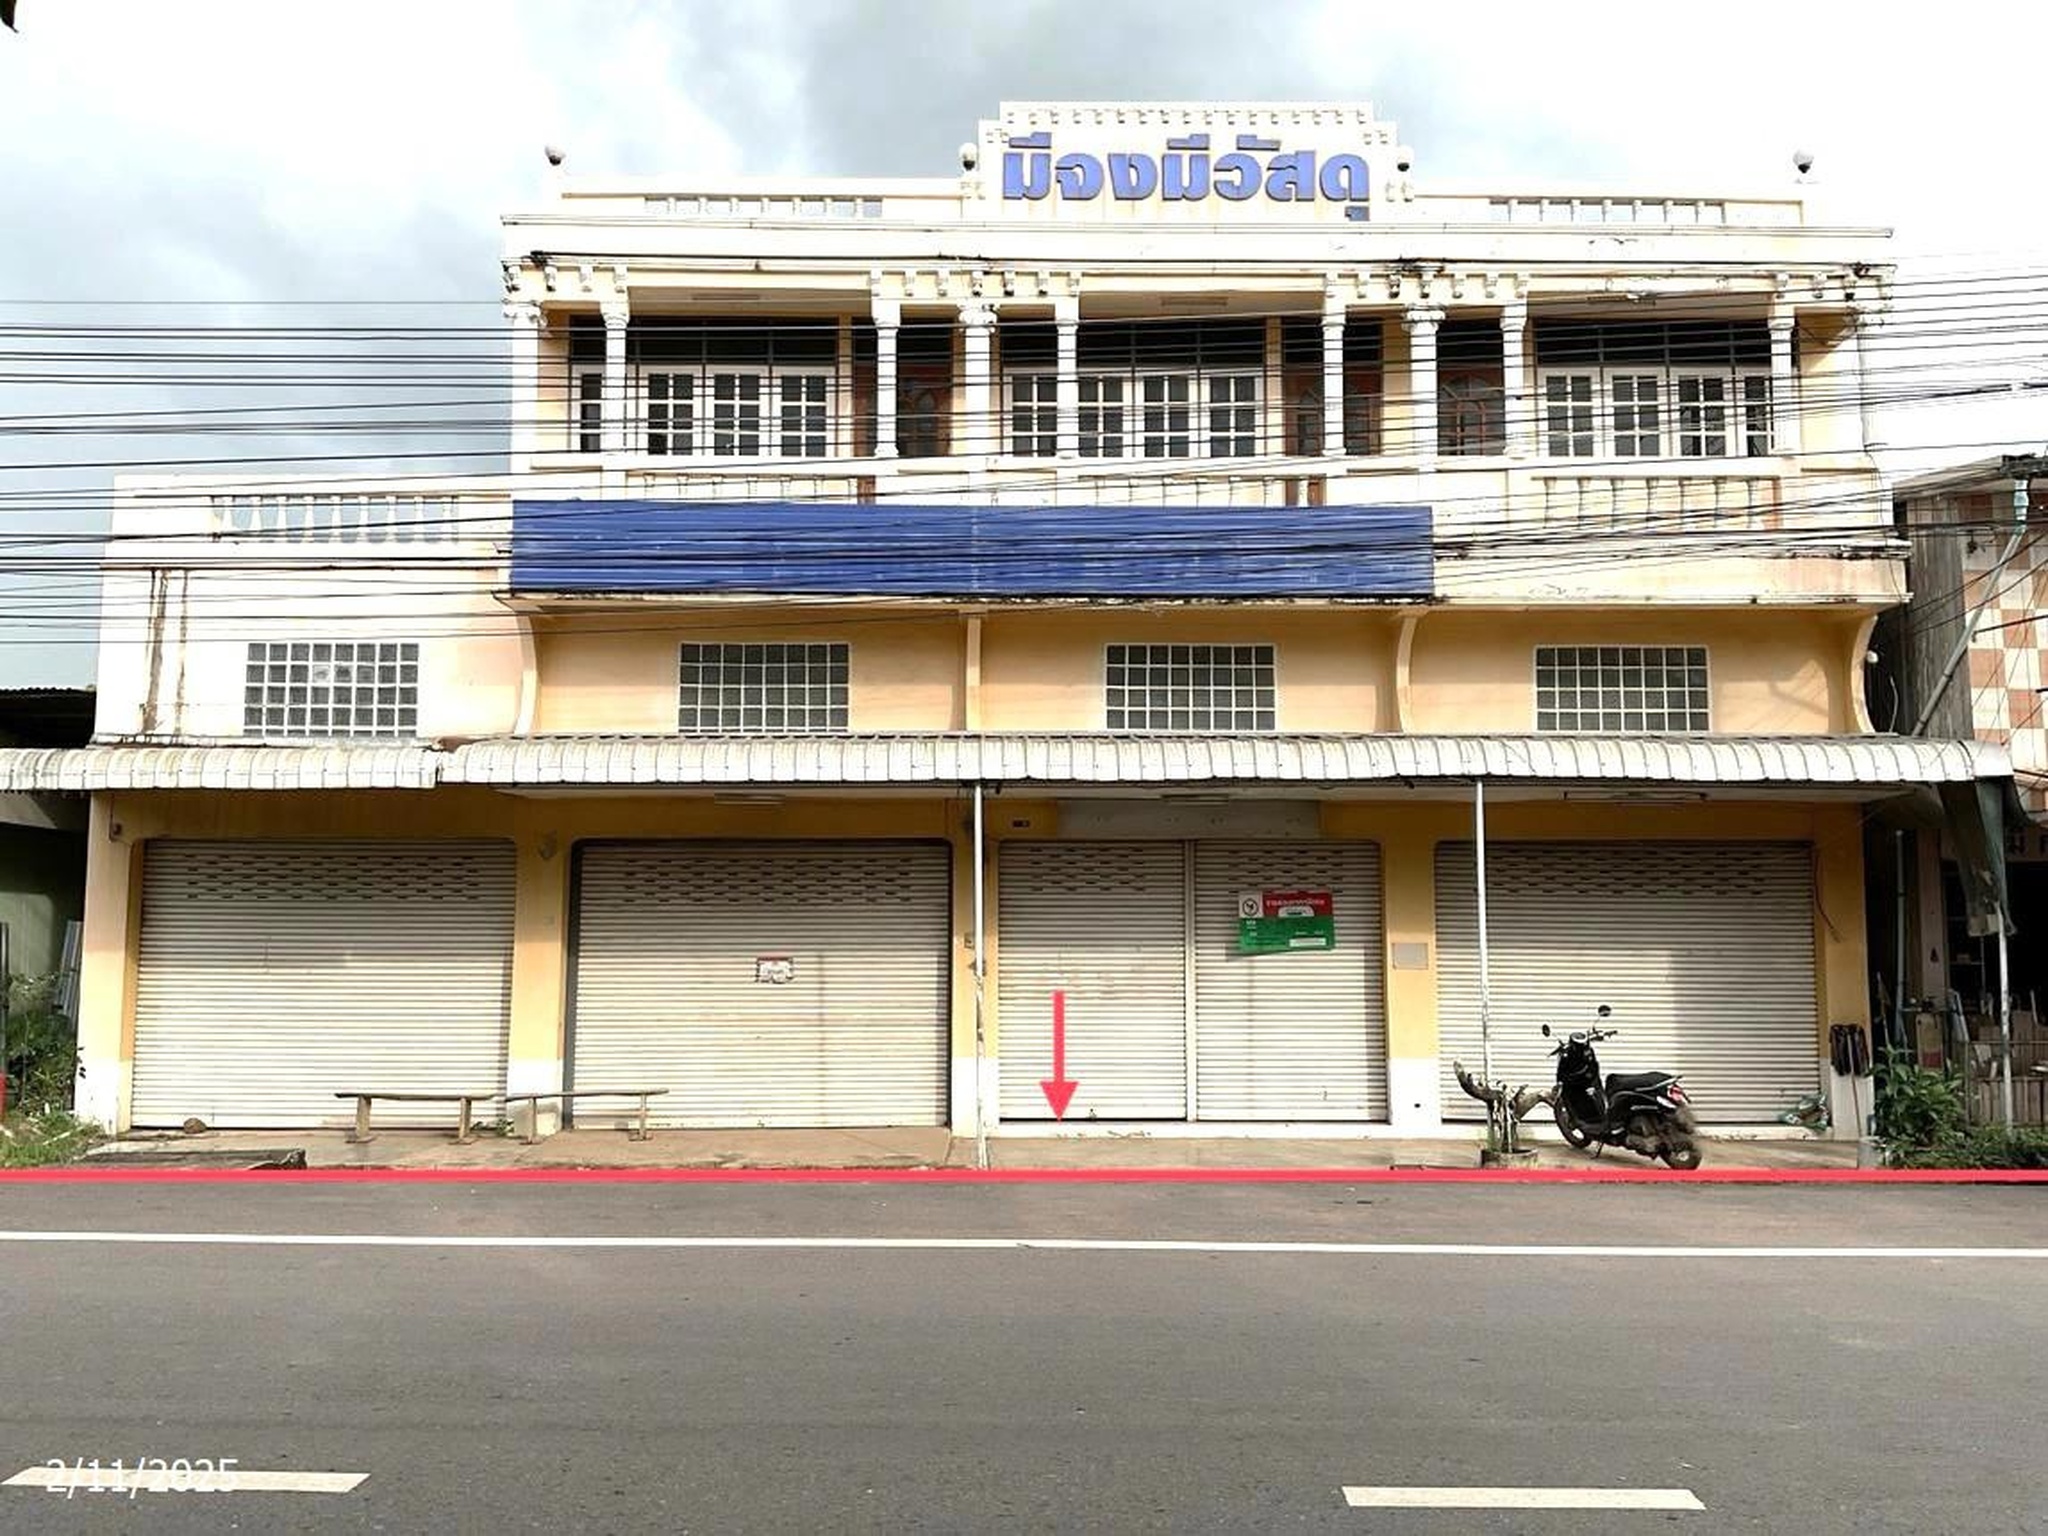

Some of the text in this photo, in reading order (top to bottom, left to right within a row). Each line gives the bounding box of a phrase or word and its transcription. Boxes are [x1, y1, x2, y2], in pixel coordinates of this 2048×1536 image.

[1003, 132, 1369, 221] มีจงมีวัสดุ
